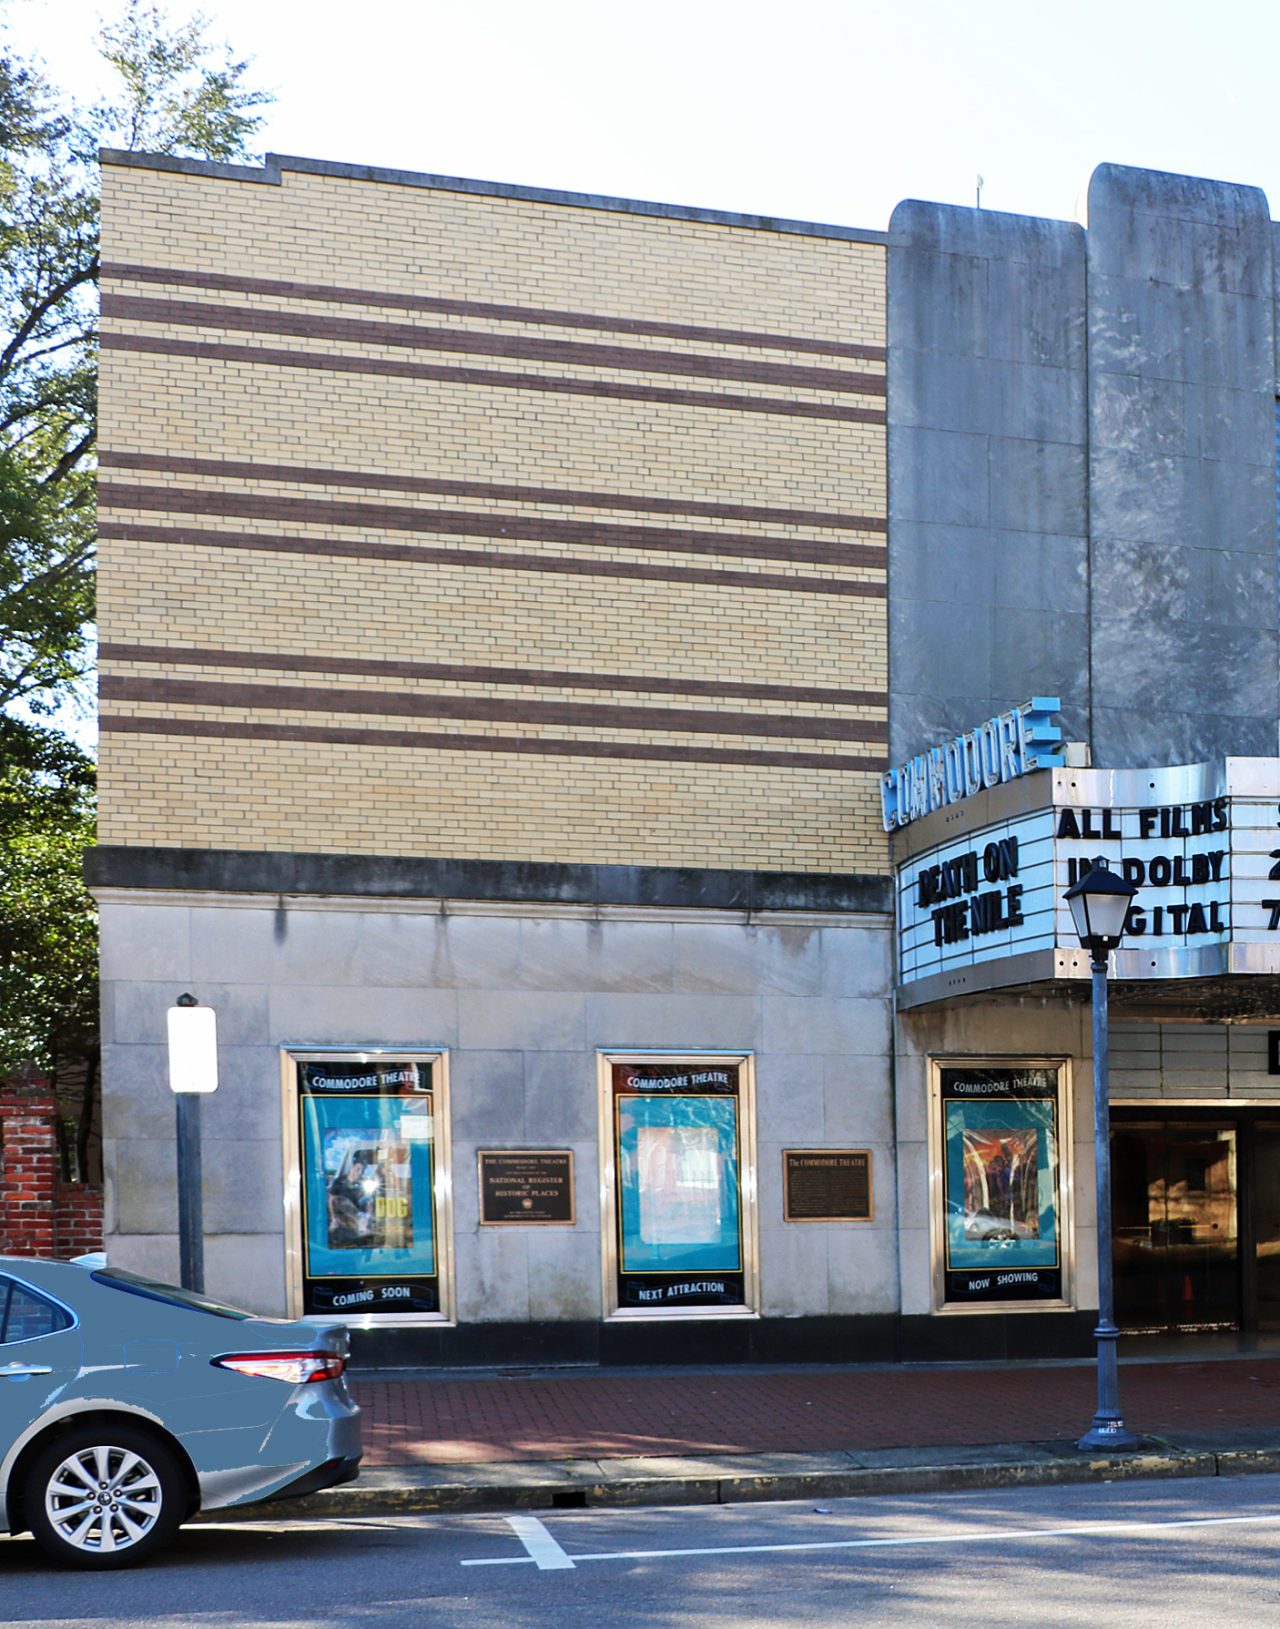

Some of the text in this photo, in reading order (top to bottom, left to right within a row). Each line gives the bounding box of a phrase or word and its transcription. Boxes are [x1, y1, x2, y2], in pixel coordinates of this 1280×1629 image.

[881, 697, 1065, 832] COMMODORE
[1057, 798, 1228, 839] ALL FILMS
[918, 835, 1018, 908] DEATH ON
[1122, 850, 1224, 887] DOLBY
[931, 883, 1024, 947] THE NILE
[1124, 901, 1224, 936] GITAL
[312, 1075, 378, 1089] COMMODORE
[627, 1071, 729, 1089] COMMODORE THEATRE
[953, 1076, 1048, 1093] COMMODORE THEATRE
[375, 1196, 408, 1218] DOG
[638, 1282, 725, 1300] NEXT ATTRACTION
[968, 1272, 1039, 1290] NOW SHOWING
[332, 1286, 411, 1306] COMING SOON
